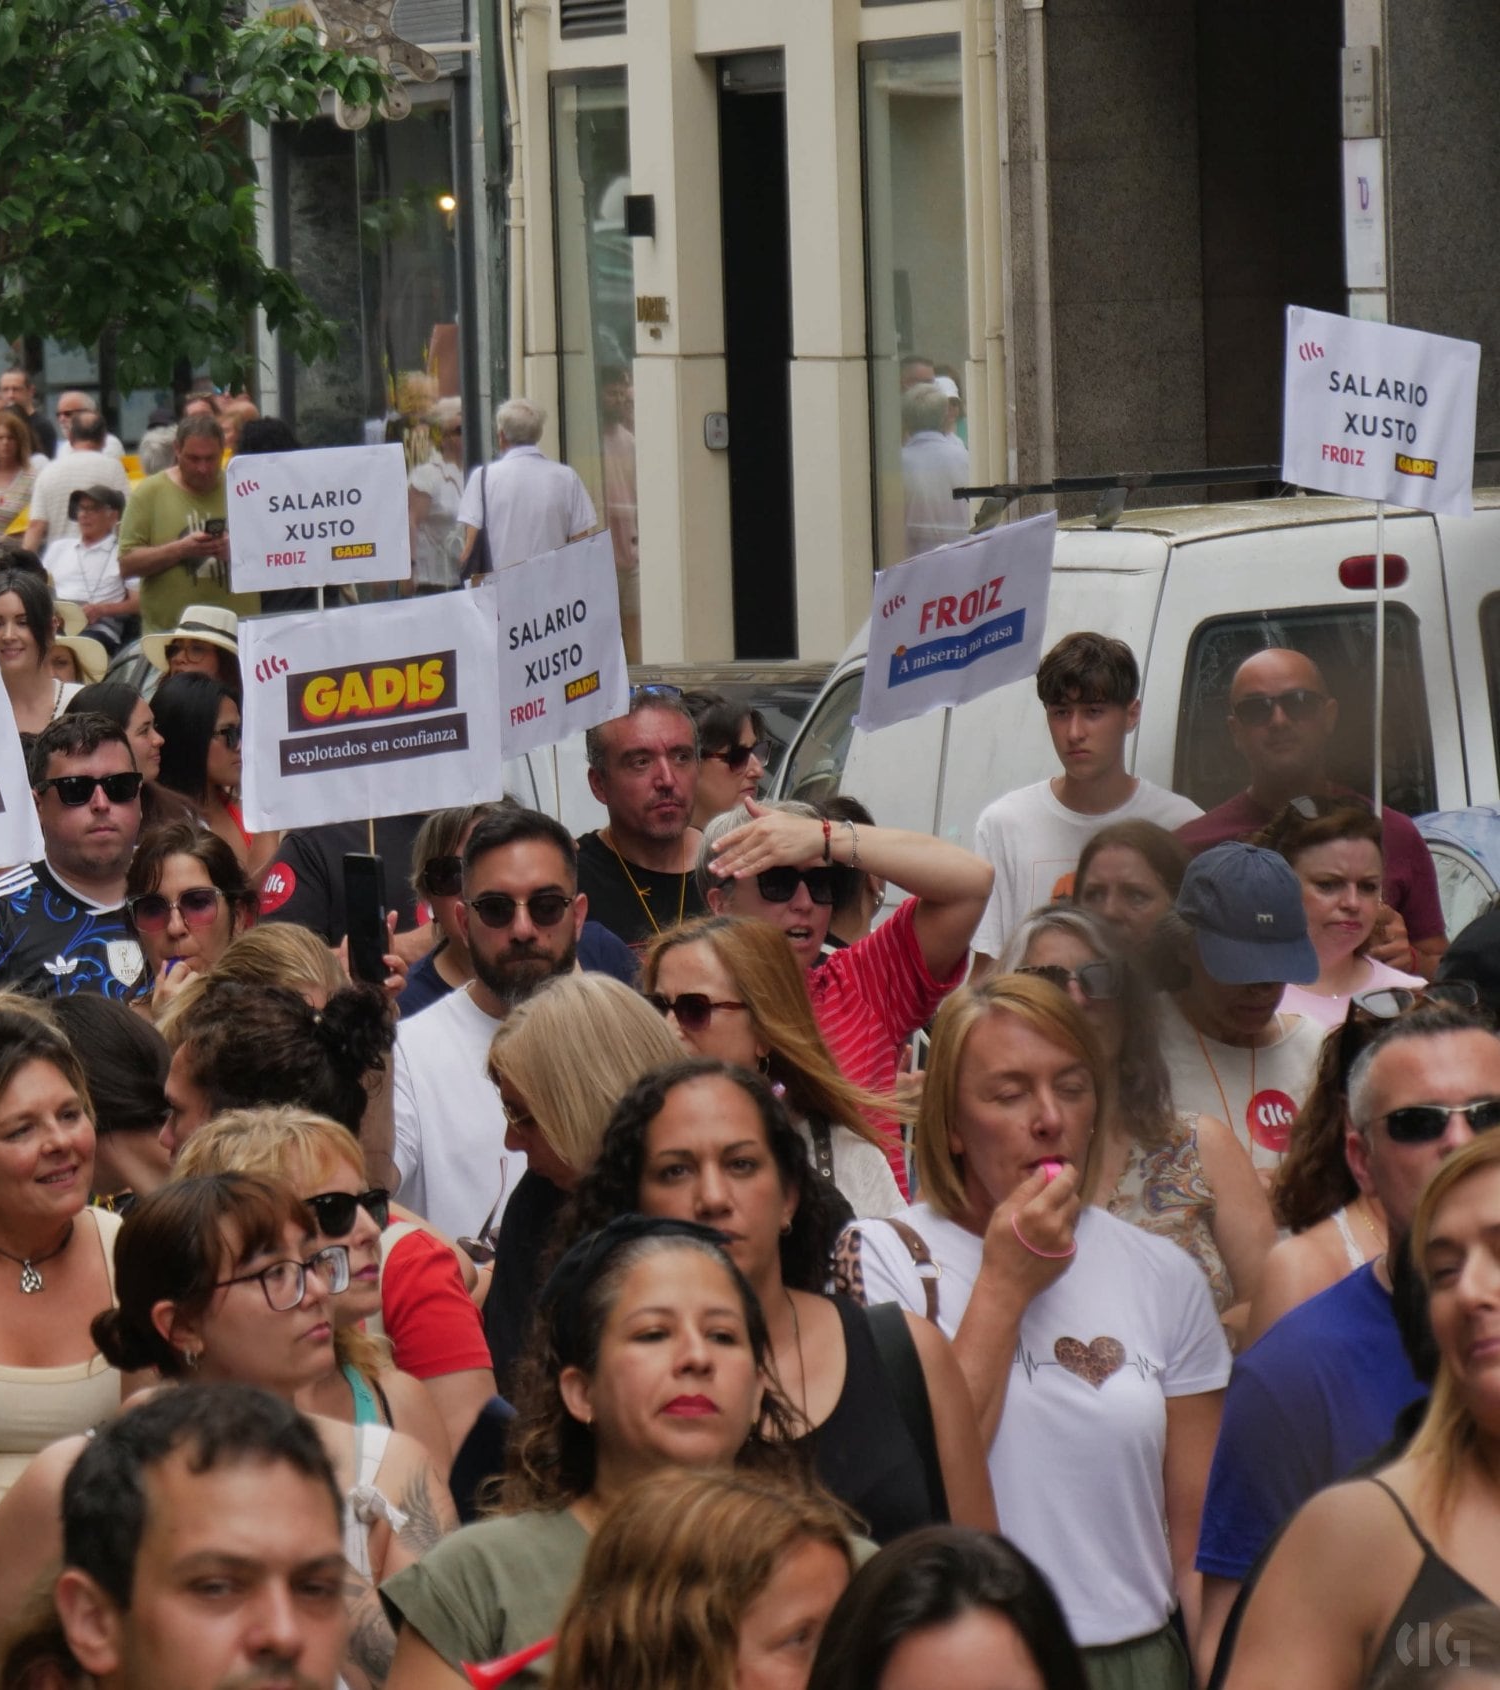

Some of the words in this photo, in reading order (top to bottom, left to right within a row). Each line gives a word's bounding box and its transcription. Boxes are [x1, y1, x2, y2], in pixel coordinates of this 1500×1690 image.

[1329, 371, 1428, 407] SALARIO
[1344, 412, 1417, 444] XUSTO
[1322, 444, 1365, 466] FROIZ
[1398, 455, 1436, 477] GADIS
[269, 488, 362, 513] SALARIO
[285, 519, 355, 541] XUSTO
[266, 551, 306, 567] FROIZ
[334, 544, 374, 559] GADIS
[919, 576, 1006, 635] FROIZ
[509, 600, 587, 650] SALARIO
[525, 643, 583, 687] XUSTO
[898, 661, 909, 674] A
[913, 645, 967, 669] miseria
[969, 638, 982, 653] na
[984, 626, 1013, 645] casa
[302, 659, 446, 723] GADIS
[510, 698, 547, 727] FROIZ
[567, 675, 598, 700] GADIS
[288, 741, 367, 766] explotados
[371, 739, 389, 753] en
[392, 728, 457, 750] confianza
